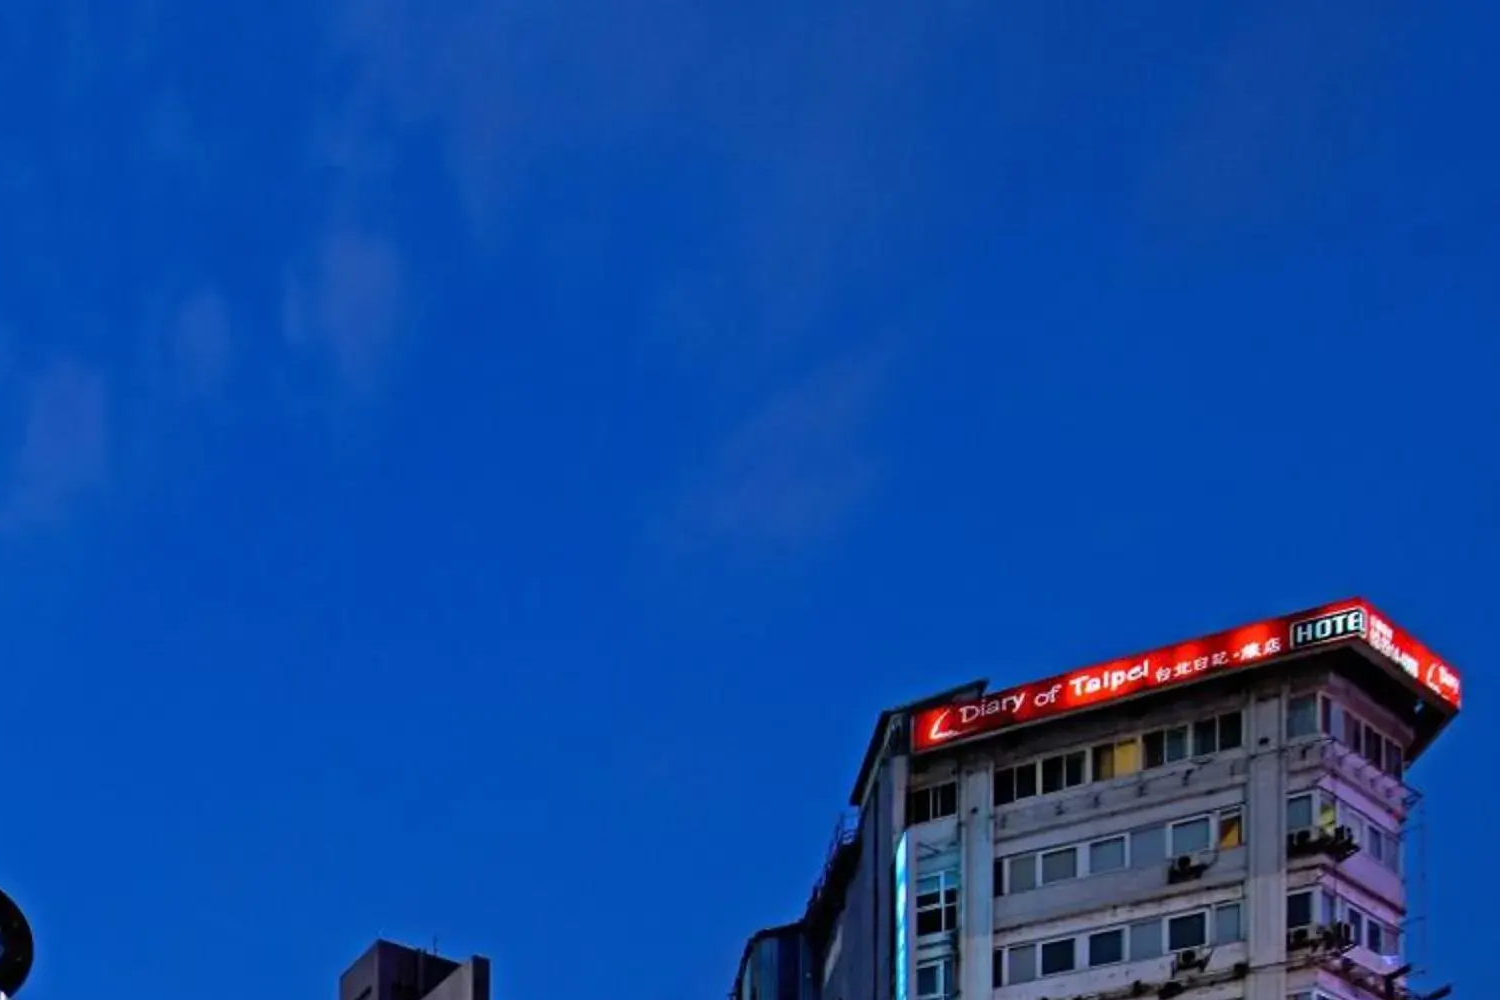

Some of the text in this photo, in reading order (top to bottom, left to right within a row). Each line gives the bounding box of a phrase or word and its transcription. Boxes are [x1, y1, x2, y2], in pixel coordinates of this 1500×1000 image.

[959, 658, 1150, 724] Diary of Taipei
